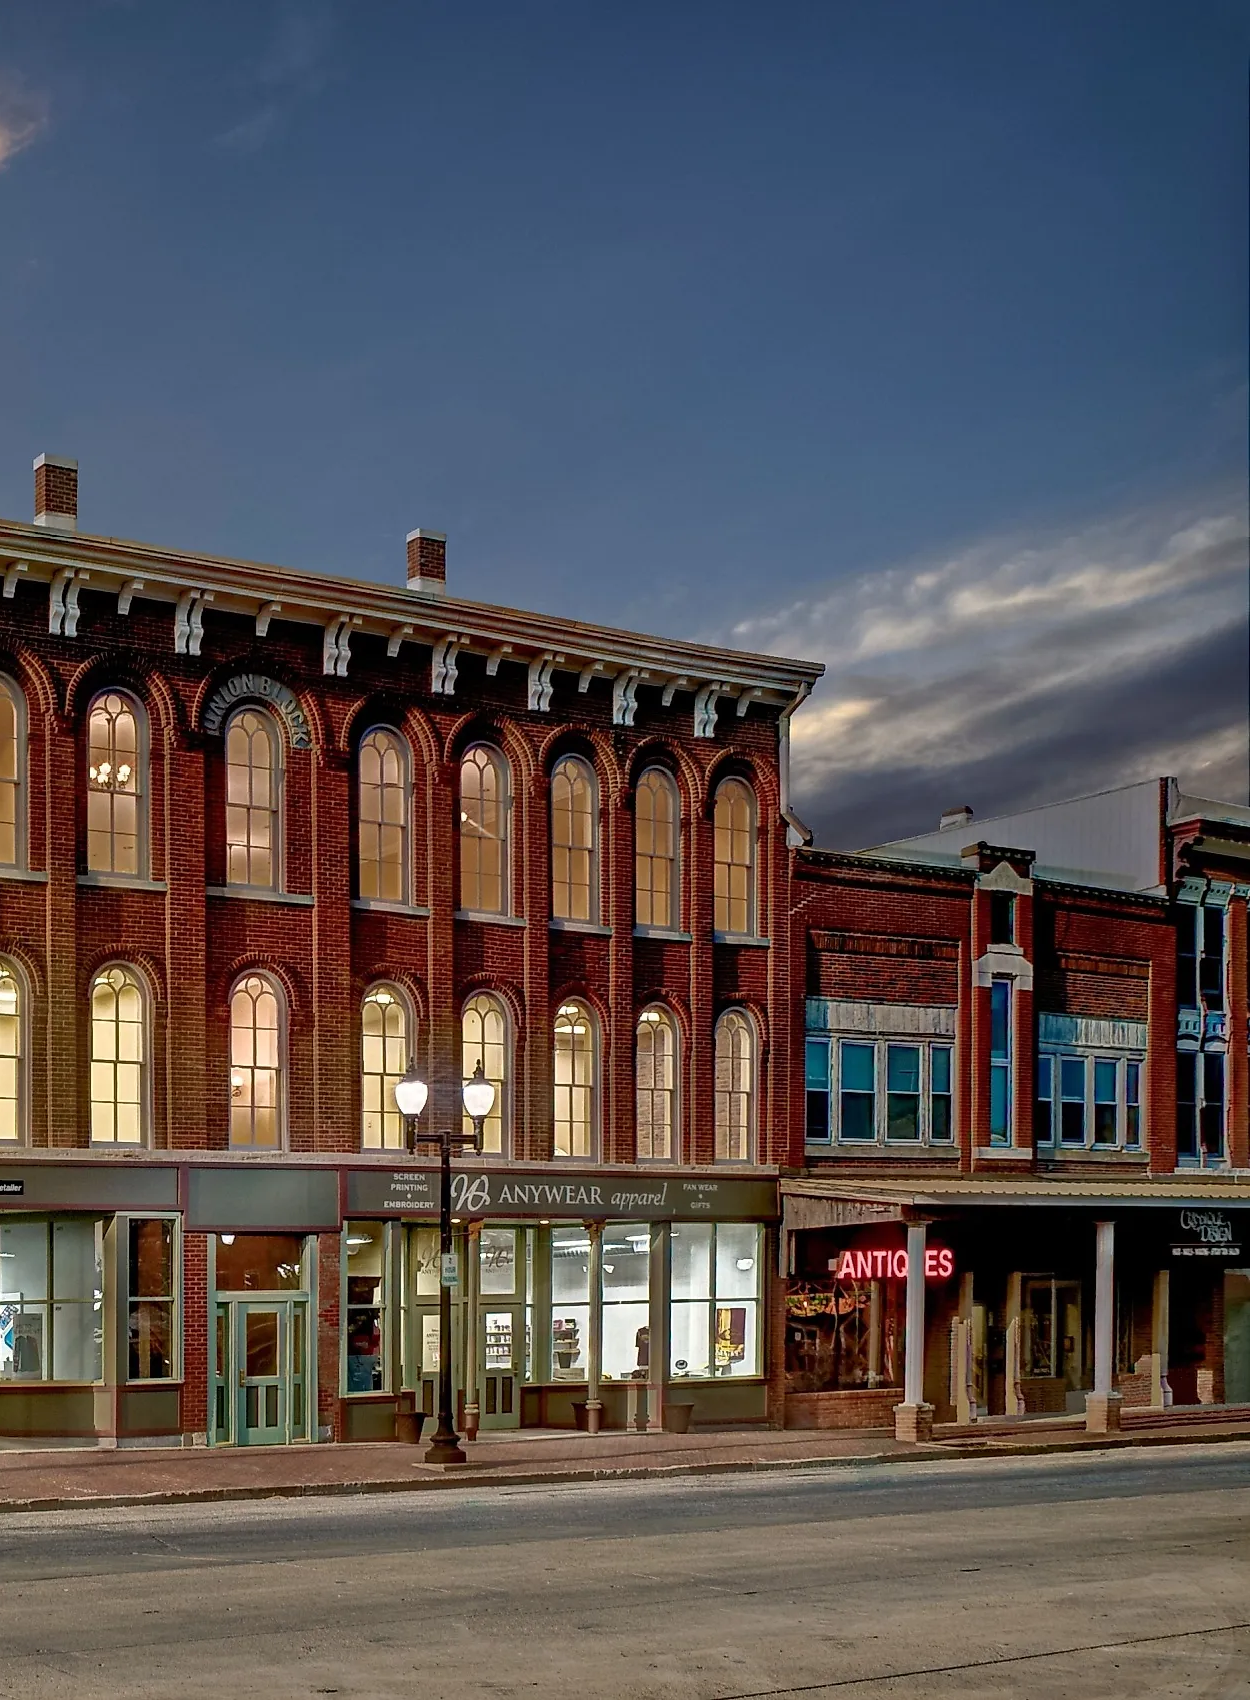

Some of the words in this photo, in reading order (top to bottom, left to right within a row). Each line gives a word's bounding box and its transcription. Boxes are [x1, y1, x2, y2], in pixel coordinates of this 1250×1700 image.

[203, 673, 255, 736] UNION
[393, 1173, 426, 1181] SCREEN
[390, 1183, 429, 1192] PRINTING
[682, 1183, 697, 1191] FAN
[497, 1184, 605, 1205] ANYWEAR
[610, 1182, 668, 1211] apparel
[383, 1200, 435, 1209] EMBROIDERY
[690, 1201, 711, 1209] GIFTS
[837, 1249, 953, 1279] ANTIQES
